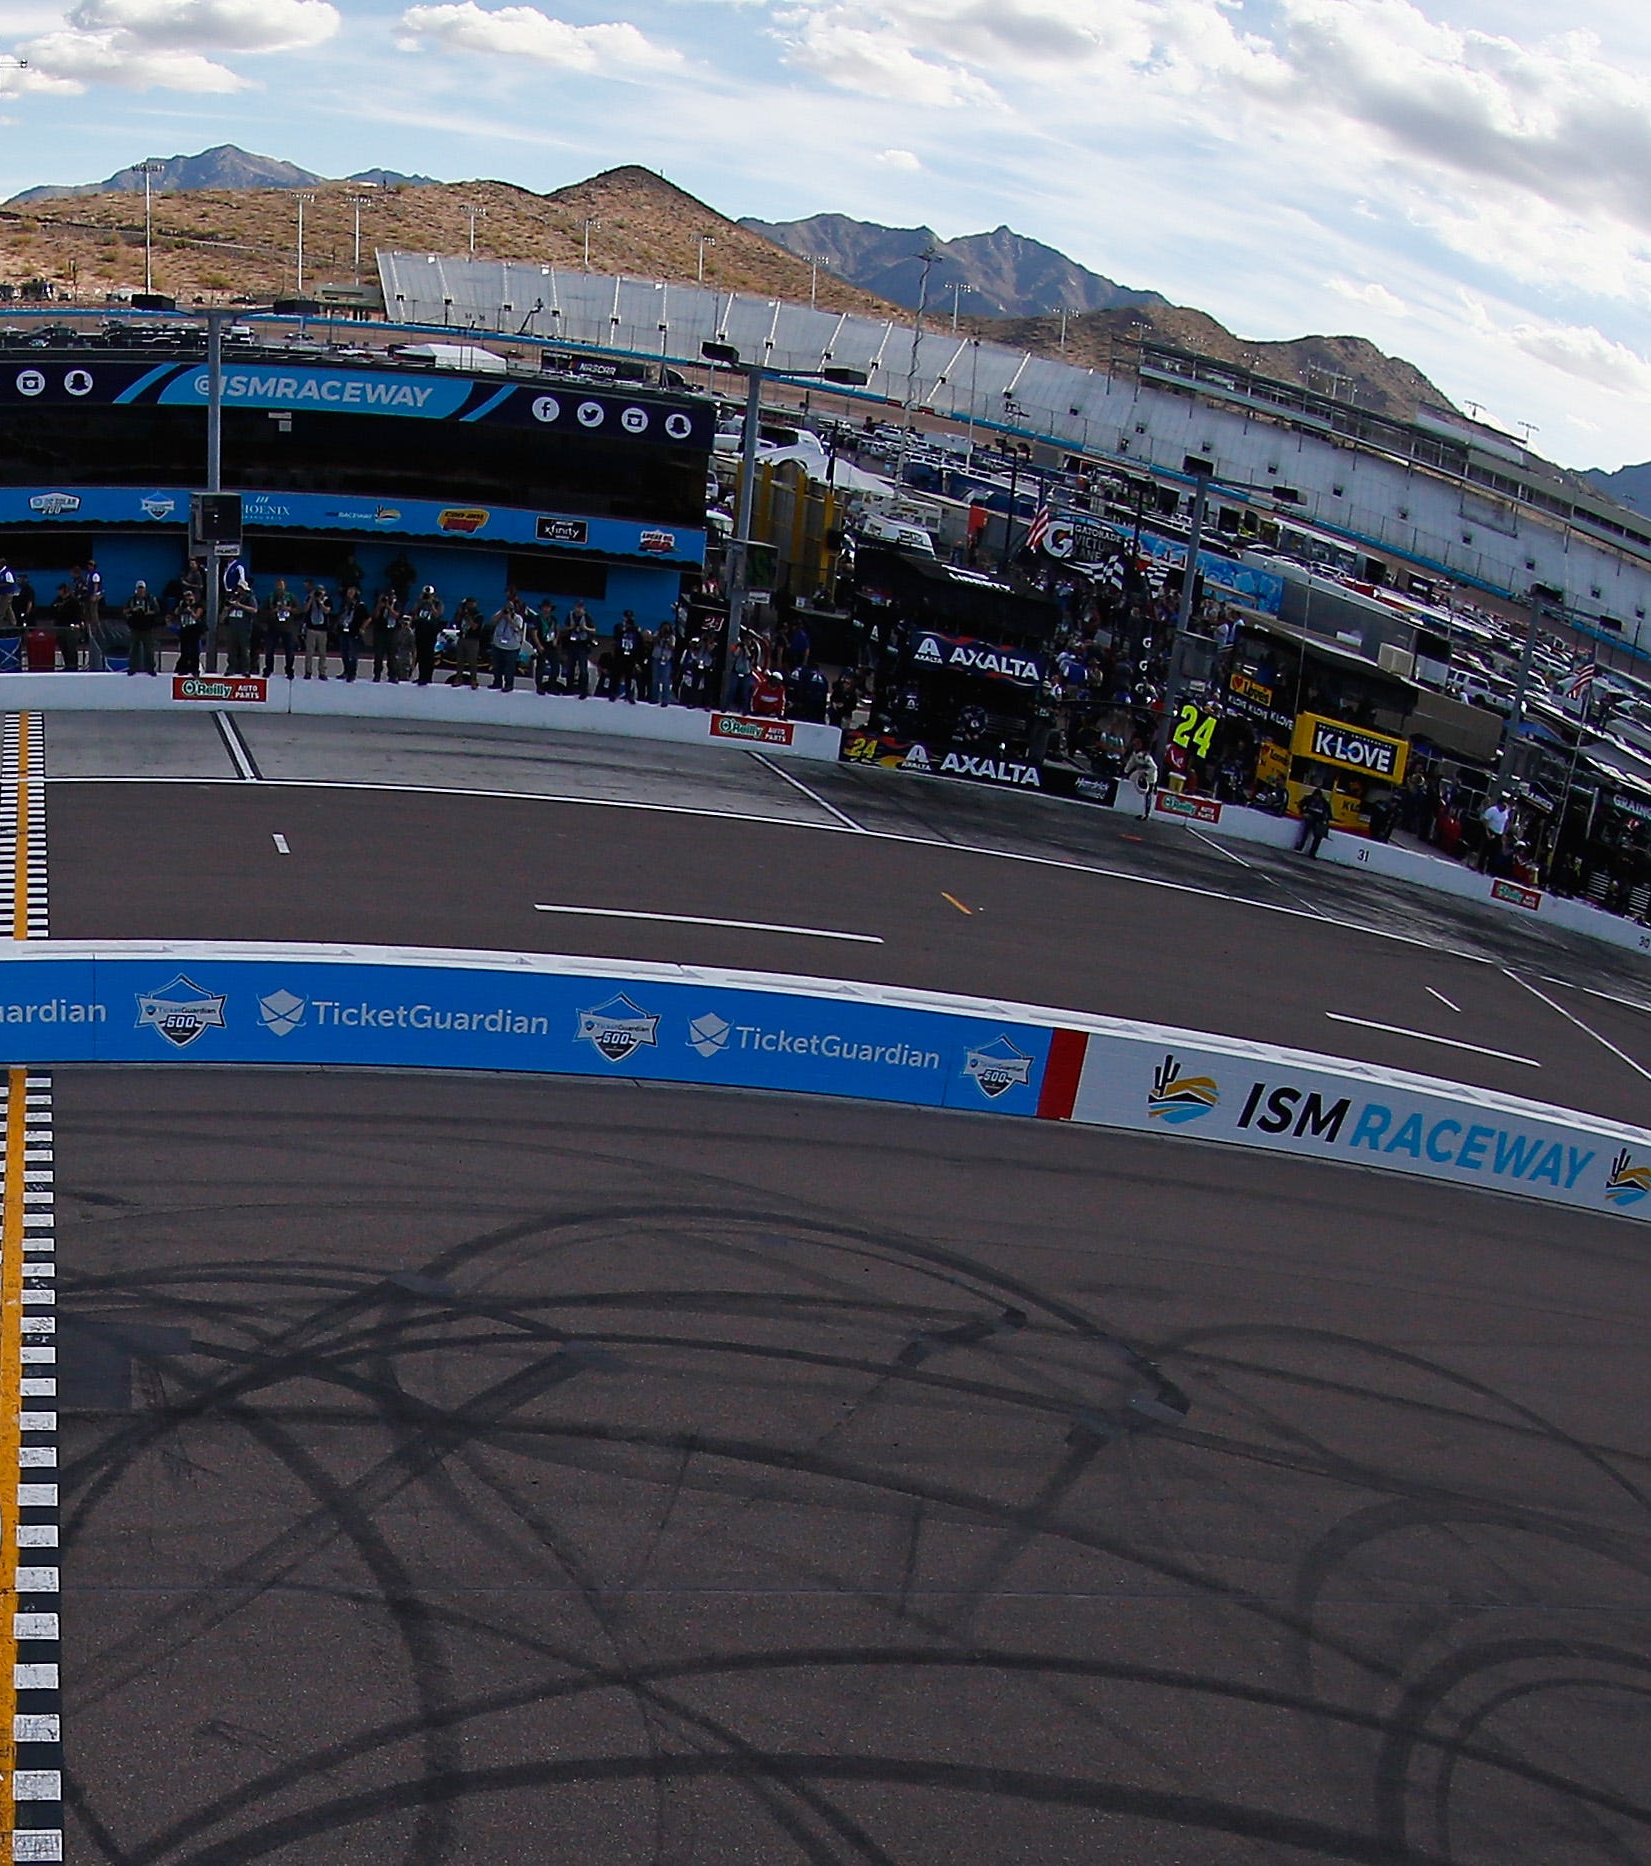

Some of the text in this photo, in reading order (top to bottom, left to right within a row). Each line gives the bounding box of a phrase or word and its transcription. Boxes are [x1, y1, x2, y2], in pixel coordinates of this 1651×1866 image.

[579, 363, 616, 376] NASCAR
[194, 375, 434, 408] @ISMRACEWAY
[242, 504, 290, 516] HOENIX
[545, 524, 579, 539] xfinity
[1075, 523, 1122, 543] GATORADE
[913, 653, 943, 665] AXALTA
[949, 647, 1039, 681] AXALTA
[182, 680, 232, 698] O'Reilly
[719, 718, 765, 739] O'Reilly
[1173, 704, 1218, 759] 24
[853, 738, 878, 758] 24
[901, 761, 932, 771] AXALTA
[940, 752, 1041, 787] AXALTA
[1358, 849, 1369, 862] 31
[312, 1001, 549, 1036] TicketGuardian
[736, 1027, 940, 1071] TicketGuardian
[1237, 1082, 1595, 1190] ISM RACEWAY
